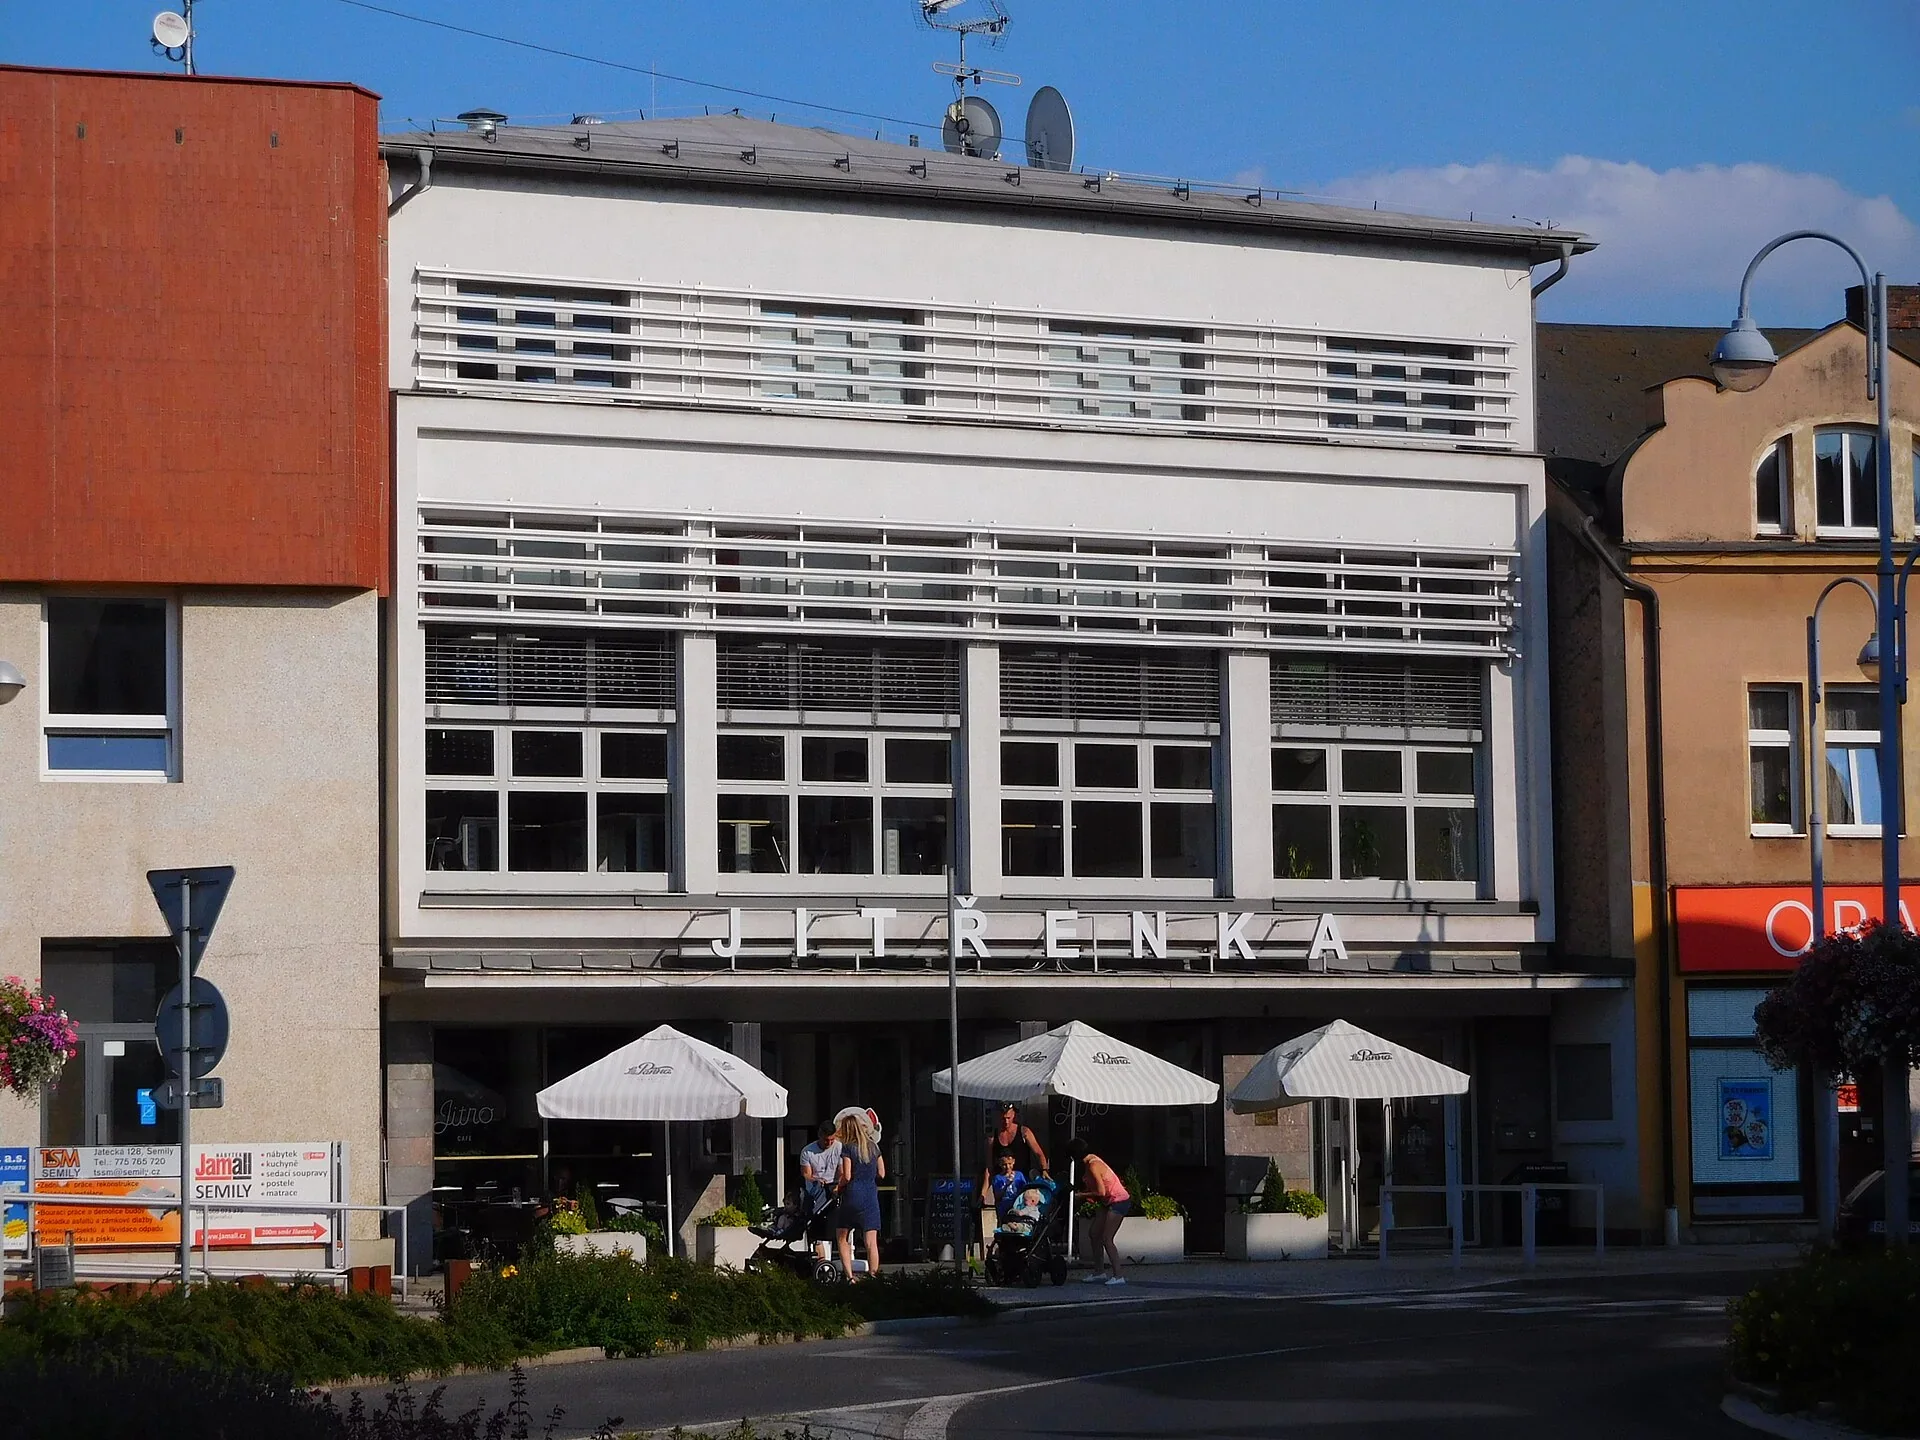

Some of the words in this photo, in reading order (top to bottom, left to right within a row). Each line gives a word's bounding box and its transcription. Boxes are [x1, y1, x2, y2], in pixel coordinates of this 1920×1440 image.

[711, 896, 1348, 959] JITŘENKA
[433, 1099, 494, 1134] Jitro
[147, 1147, 174, 1156] Semily
[266, 1150, 298, 1160] nábytek
[150, 1157, 165, 1165] 720
[195, 1152, 252, 1176] Jamall
[266, 1160, 298, 1170] kuchyně
[42, 1168, 81, 1177] SEMILY
[293, 1170, 327, 1179] soupravy
[266, 1179, 294, 1188] postele
[196, 1184, 252, 1199] SEMILY
[266, 1189, 298, 1197] matrace
